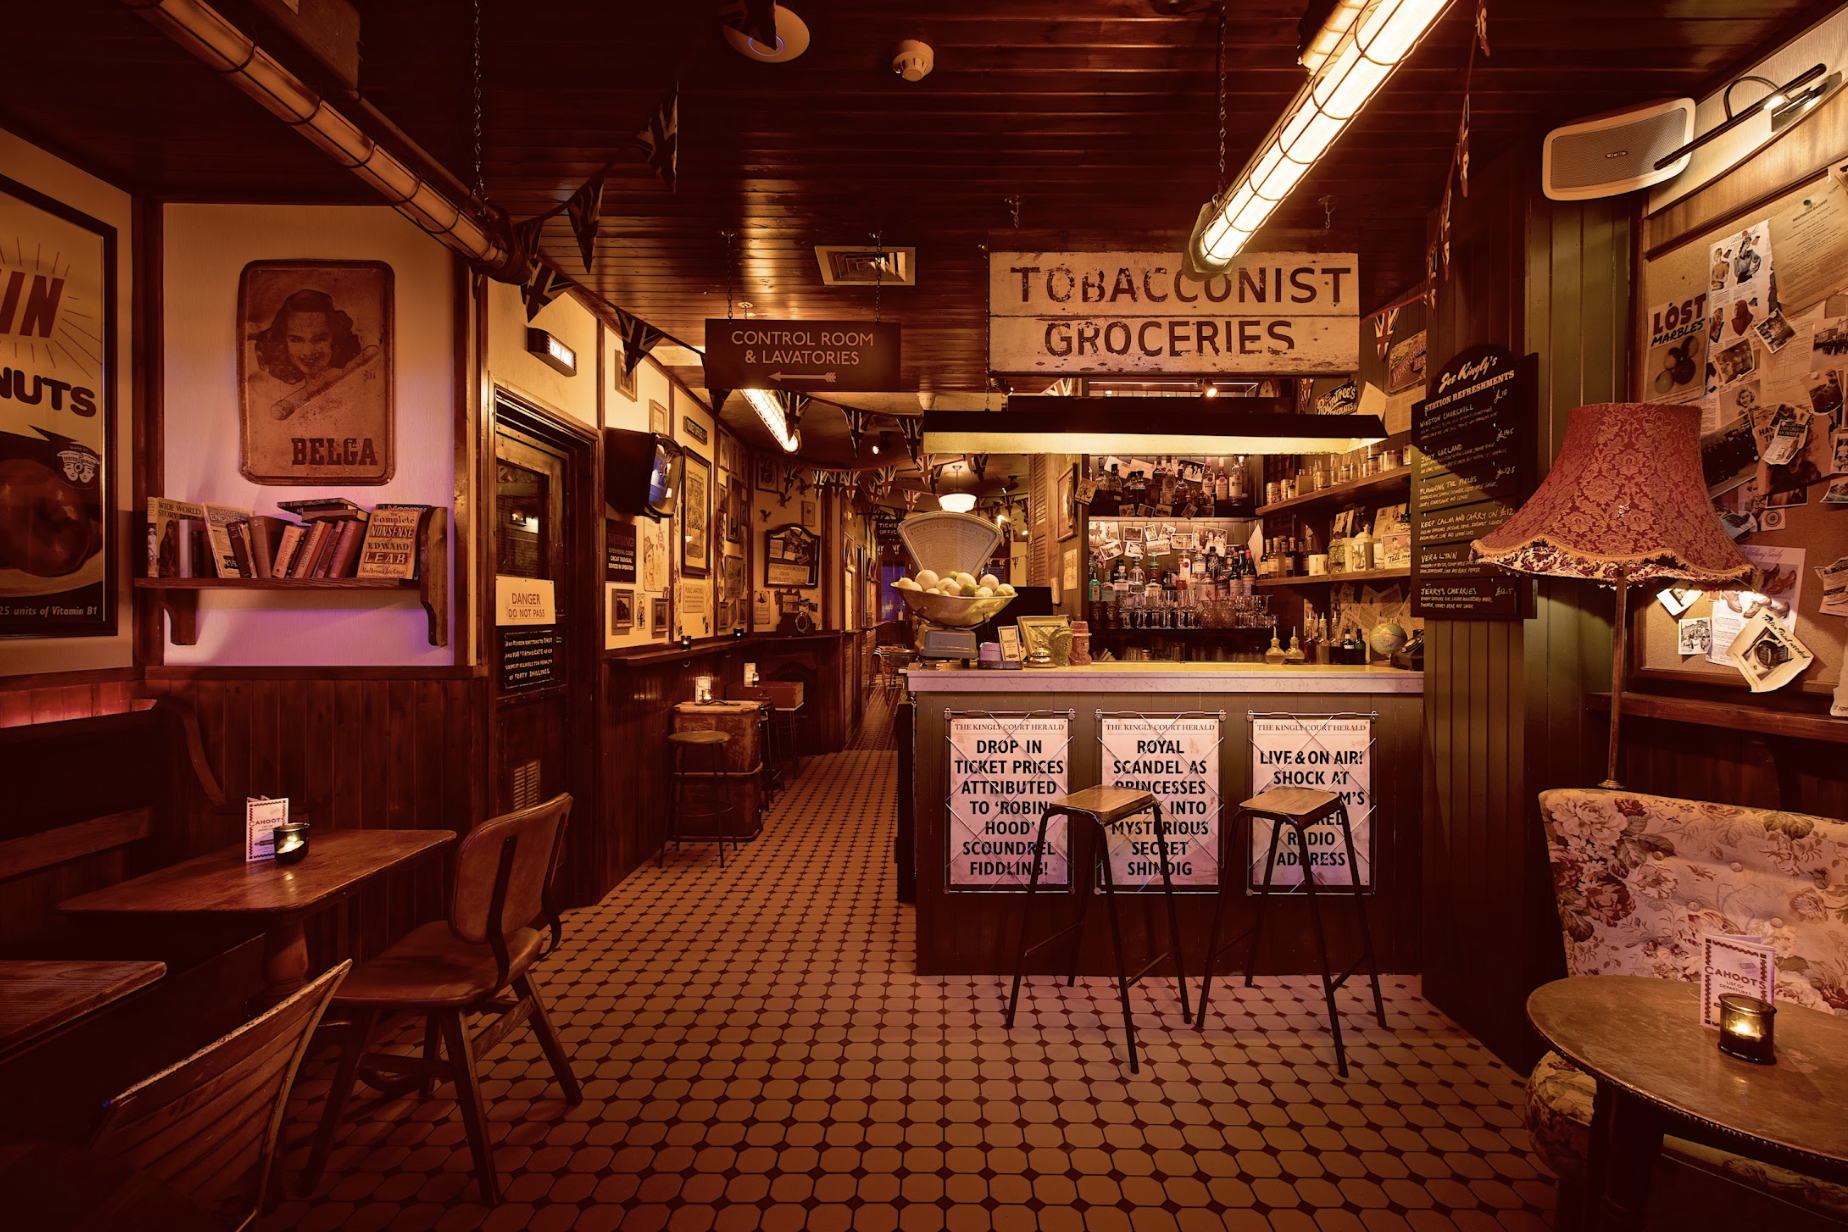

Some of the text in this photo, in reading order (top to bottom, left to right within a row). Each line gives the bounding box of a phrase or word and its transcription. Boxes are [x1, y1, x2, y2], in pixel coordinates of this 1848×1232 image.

[1010, 266, 1351, 303] TOBACCONIST
[1653, 292, 1706, 336] LOST
[732, 330, 874, 346] CONTROL ROOM
[1044, 320, 1295, 356] GROCERIES
[1651, 318, 1705, 348] MARBLES
[745, 350, 860, 366] & LAVATORIES
[1424, 370, 1515, 412] STATION REFRESHMENTS
[1442, 404, 1474, 420] CHURCHILL
[292, 438, 378, 466] BELGA
[158, 502, 202, 516] WIDE WORLD
[158, 510, 178, 519] STORY
[373, 515, 415, 525] Complete
[1420, 519, 1435, 529] KEEP
[1437, 516, 1454, 526] CALM
[1466, 512, 1486, 520] CARRY
[371, 526, 413, 538] NONSENSE
[368, 542, 409, 550] EDWARD
[364, 553, 406, 564] LEAR
[1421, 551, 1458, 563] VERA LYNN
[512, 593, 541, 605] DANGER
[14, 606, 37, 616] units
[40, 606, 50, 617] of
[52, 606, 84, 616] Vitamin
[87, 606, 98, 615] B1
[508, 609, 545, 618] DO NOT PASS
[976, 740, 1042, 754] DROP IN
[1137, 740, 1184, 754] ROYAL
[1260, 751, 1364, 765] LIVE & ON AIR!
[954, 760, 1064, 774] TICKET PRICES
[1114, 760, 1207, 774] SCANDEL AS
[1274, 771, 1349, 785] SHOCK AT
[961, 781, 1056, 794] ATTRIBUTED
[970, 801, 990, 814] TO
[1170, 801, 1206, 814] INTO
[1288, 832, 1335, 845] RDIO
[962, 842, 1056, 855] SCOUNDREL
[1132, 842, 1188, 855] SECRET
[1276, 852, 1346, 866] ADRESS
[1128, 862, 1192, 876] SHINDIG
[1705, 966, 1766, 990] CAHOOTS
[1719, 984, 1752, 996] DEPARTURES
